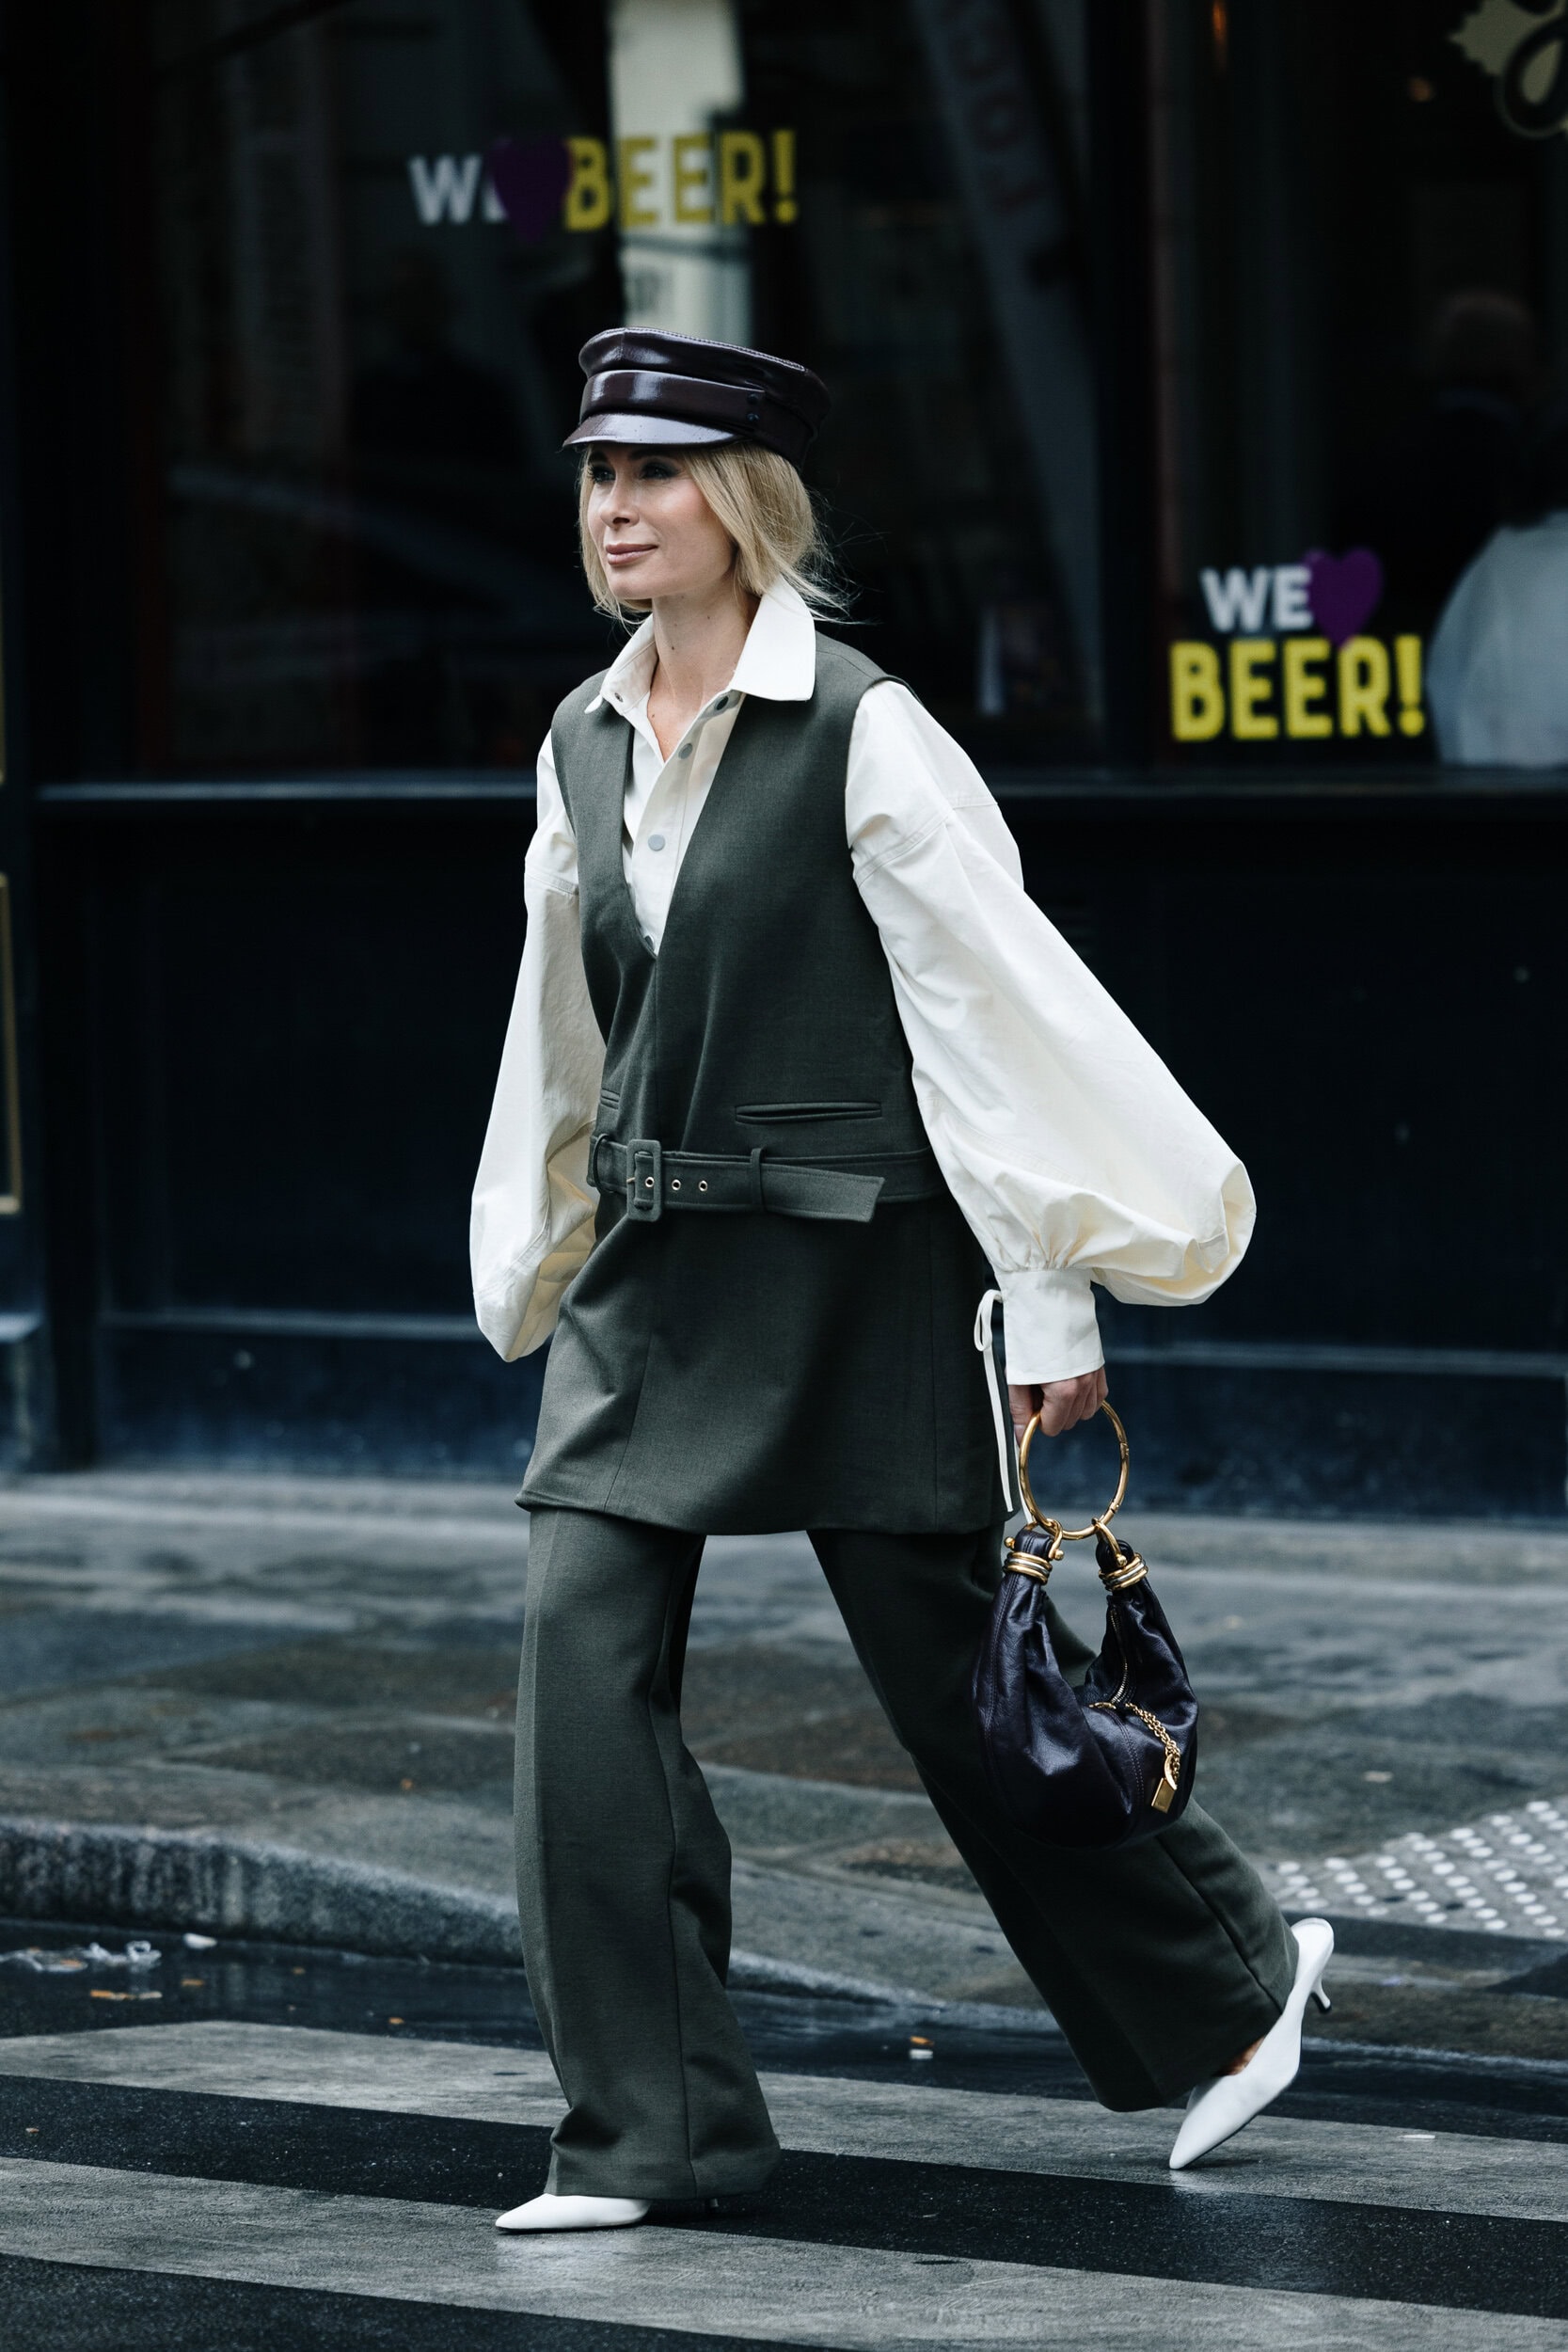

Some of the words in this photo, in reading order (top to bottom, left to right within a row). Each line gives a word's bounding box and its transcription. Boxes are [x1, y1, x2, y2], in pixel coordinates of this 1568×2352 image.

[564, 129, 799, 231] BEER!
[1200, 565, 1314, 632] WE
[1170, 633, 1425, 741] BEER!
